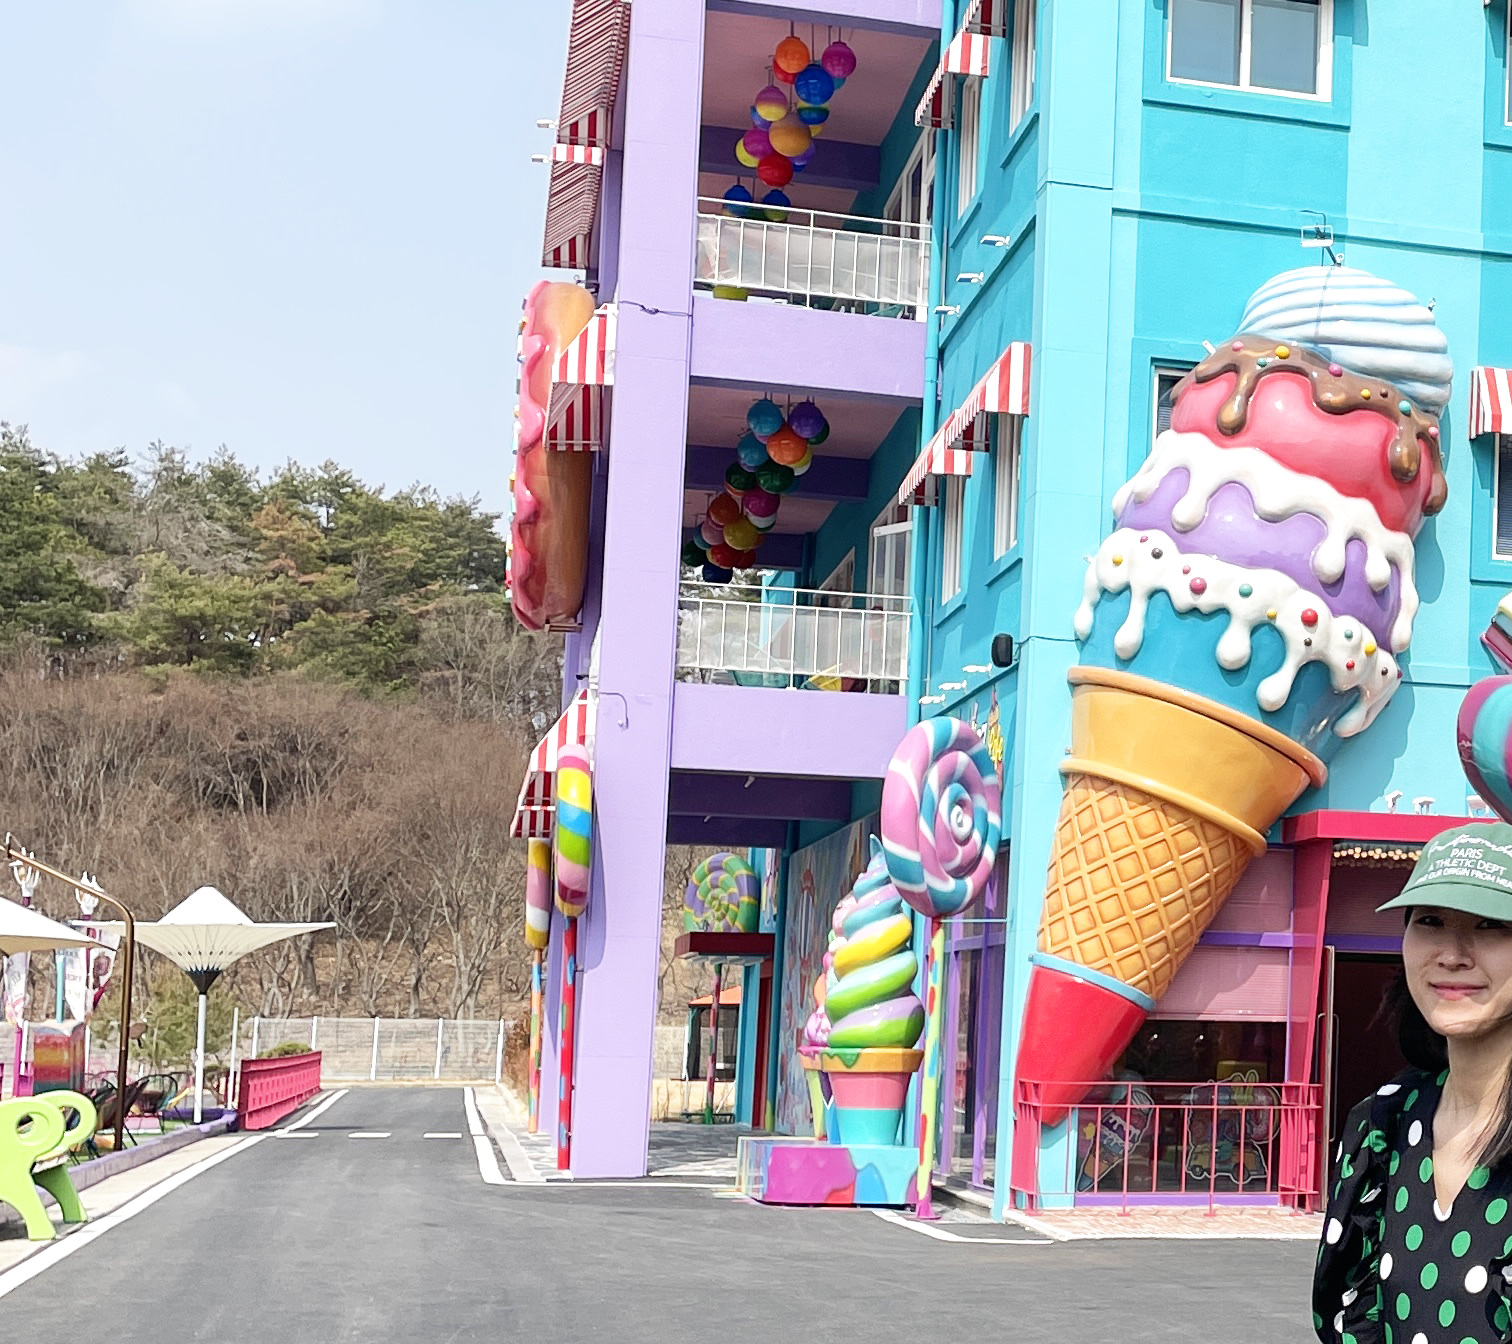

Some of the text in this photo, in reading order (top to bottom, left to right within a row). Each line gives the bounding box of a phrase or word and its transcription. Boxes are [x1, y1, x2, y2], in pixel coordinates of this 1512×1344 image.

[1450, 848, 1484, 859] PARIS
[1477, 860, 1507, 876] DEPT
[1471, 869, 1496, 883] FROM
